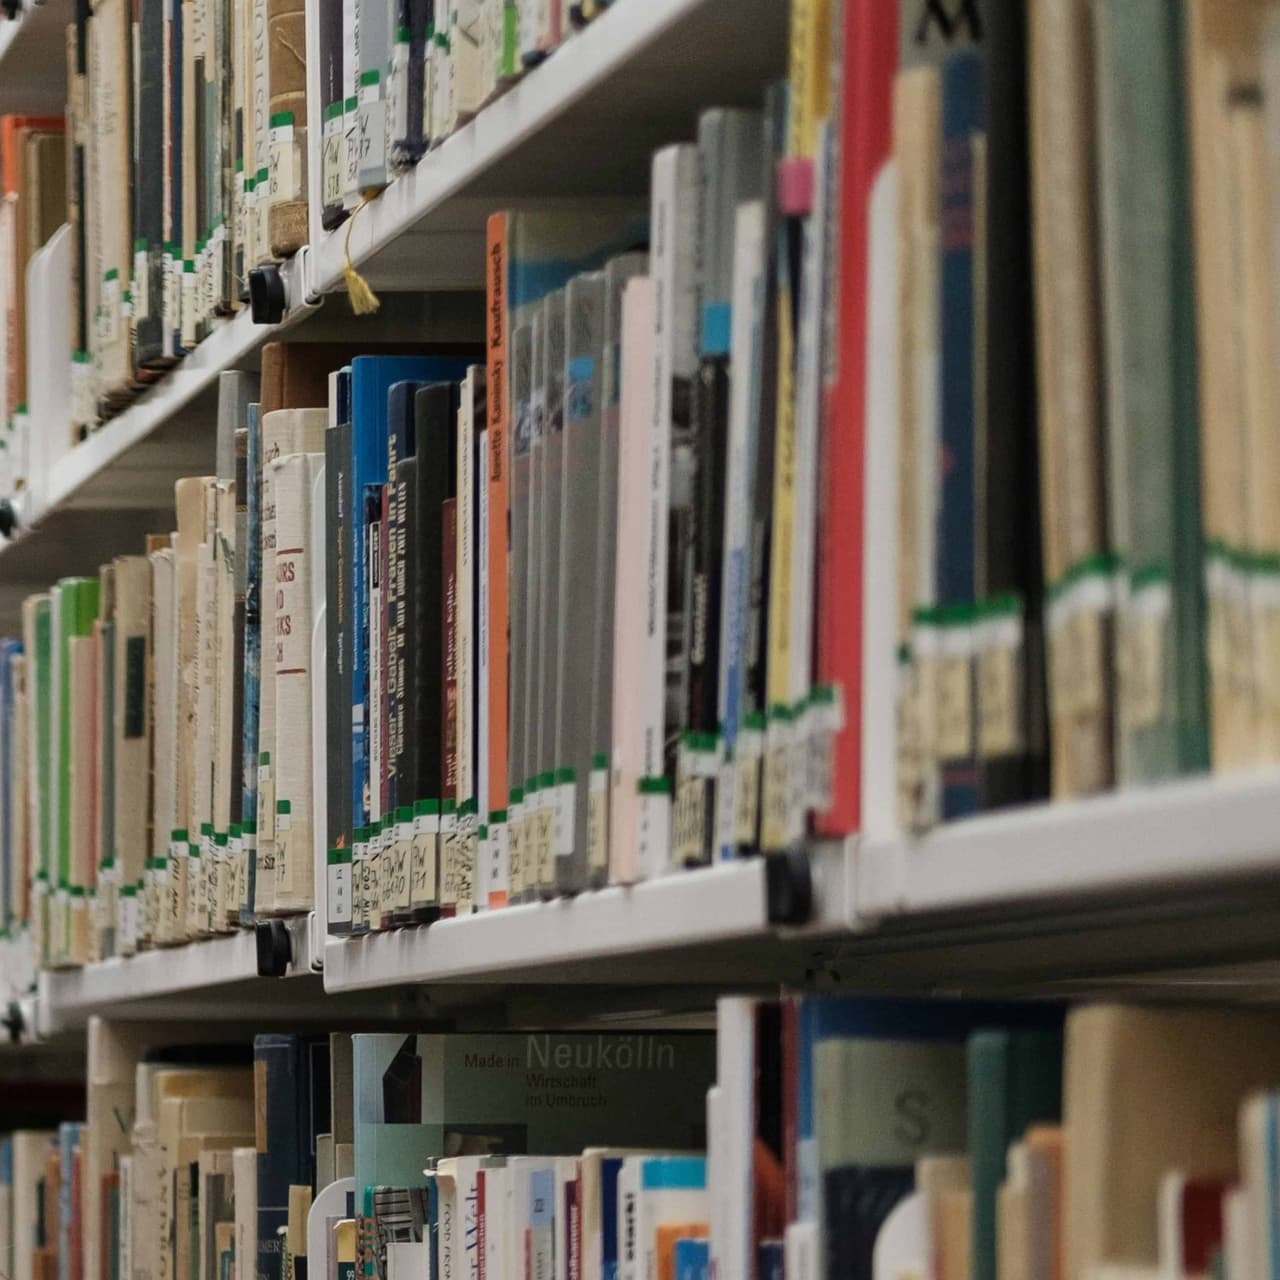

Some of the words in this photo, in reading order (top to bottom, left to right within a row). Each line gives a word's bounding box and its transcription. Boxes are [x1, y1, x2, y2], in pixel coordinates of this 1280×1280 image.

[490, 242, 503, 348] Kaufrausch
[386, 433, 397, 497] Fahrt
[387, 528, 397, 603] Frauen
[526, 1034, 675, 1070] Neukölln
[526, 1073, 597, 1090] Wirtschaft
[544, 1093, 609, 1109] Umbruch
[443, 1202, 452, 1242] FOOD
[464, 1184, 479, 1252] Welt
